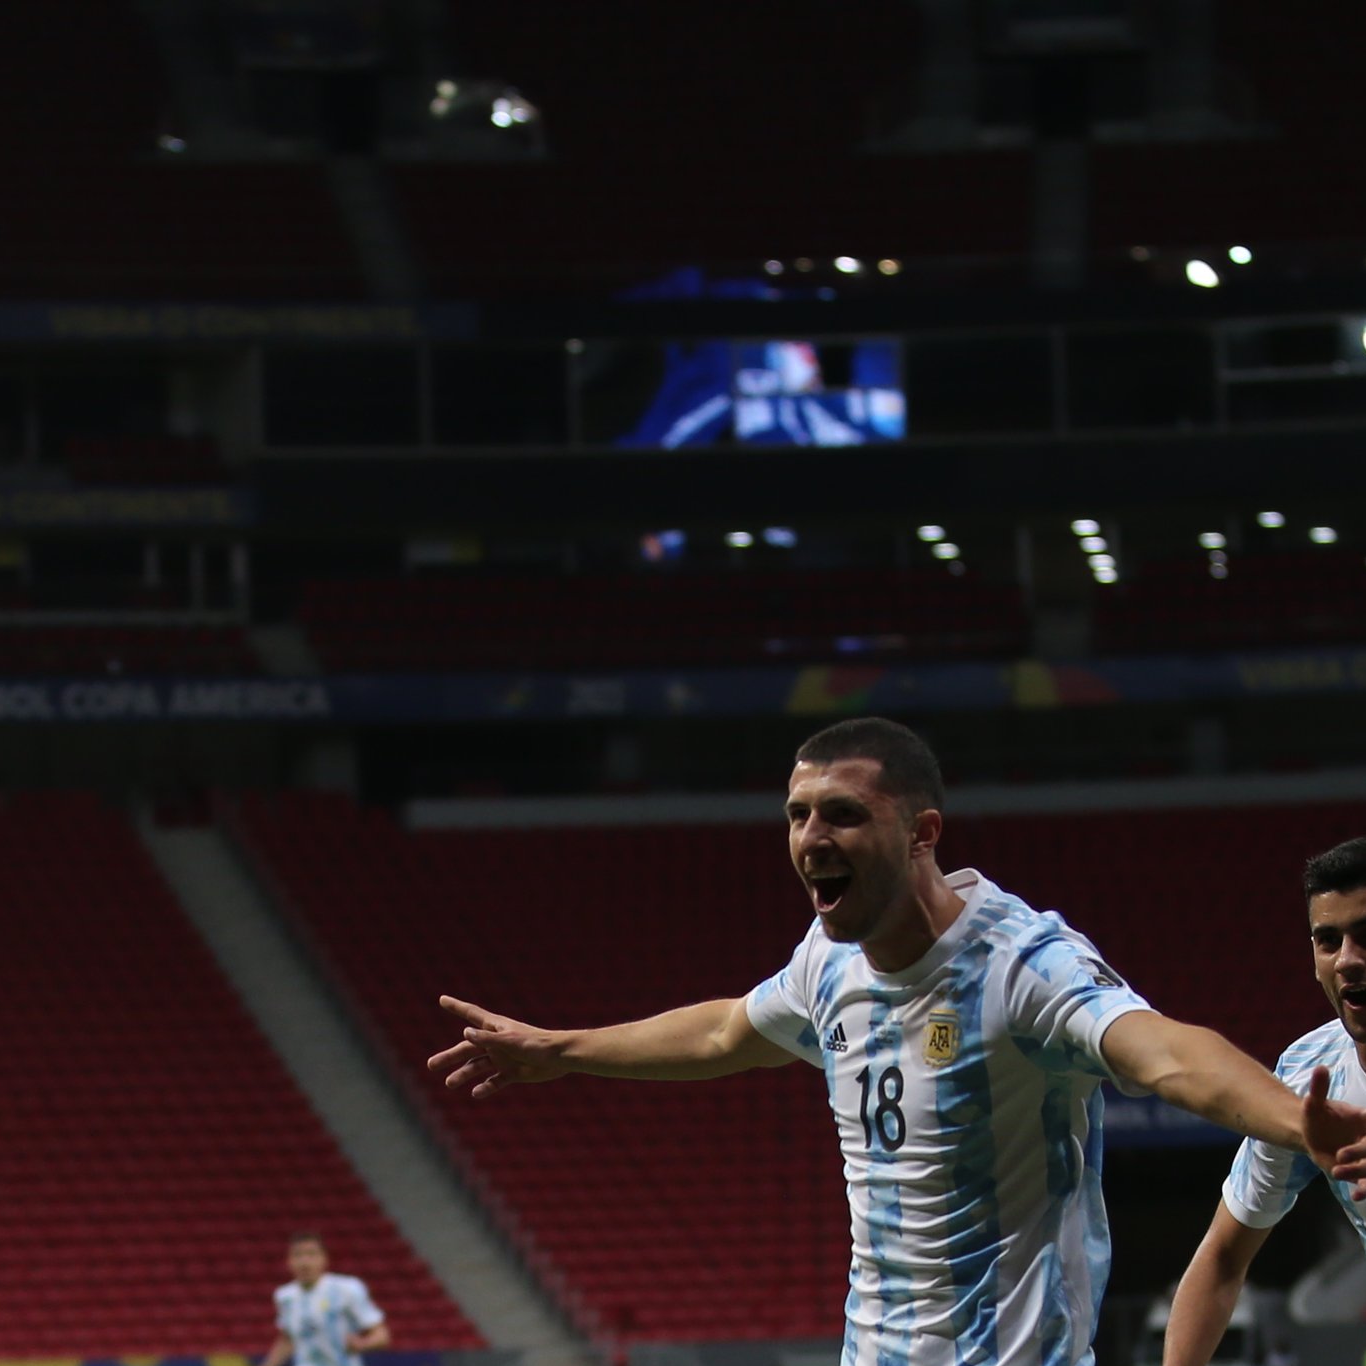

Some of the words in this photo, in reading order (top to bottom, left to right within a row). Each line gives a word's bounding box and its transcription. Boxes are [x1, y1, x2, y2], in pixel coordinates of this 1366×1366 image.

[62, 681, 161, 719] COPA
[169, 680, 332, 717] AMERICA
[855, 1065, 906, 1152] 18
